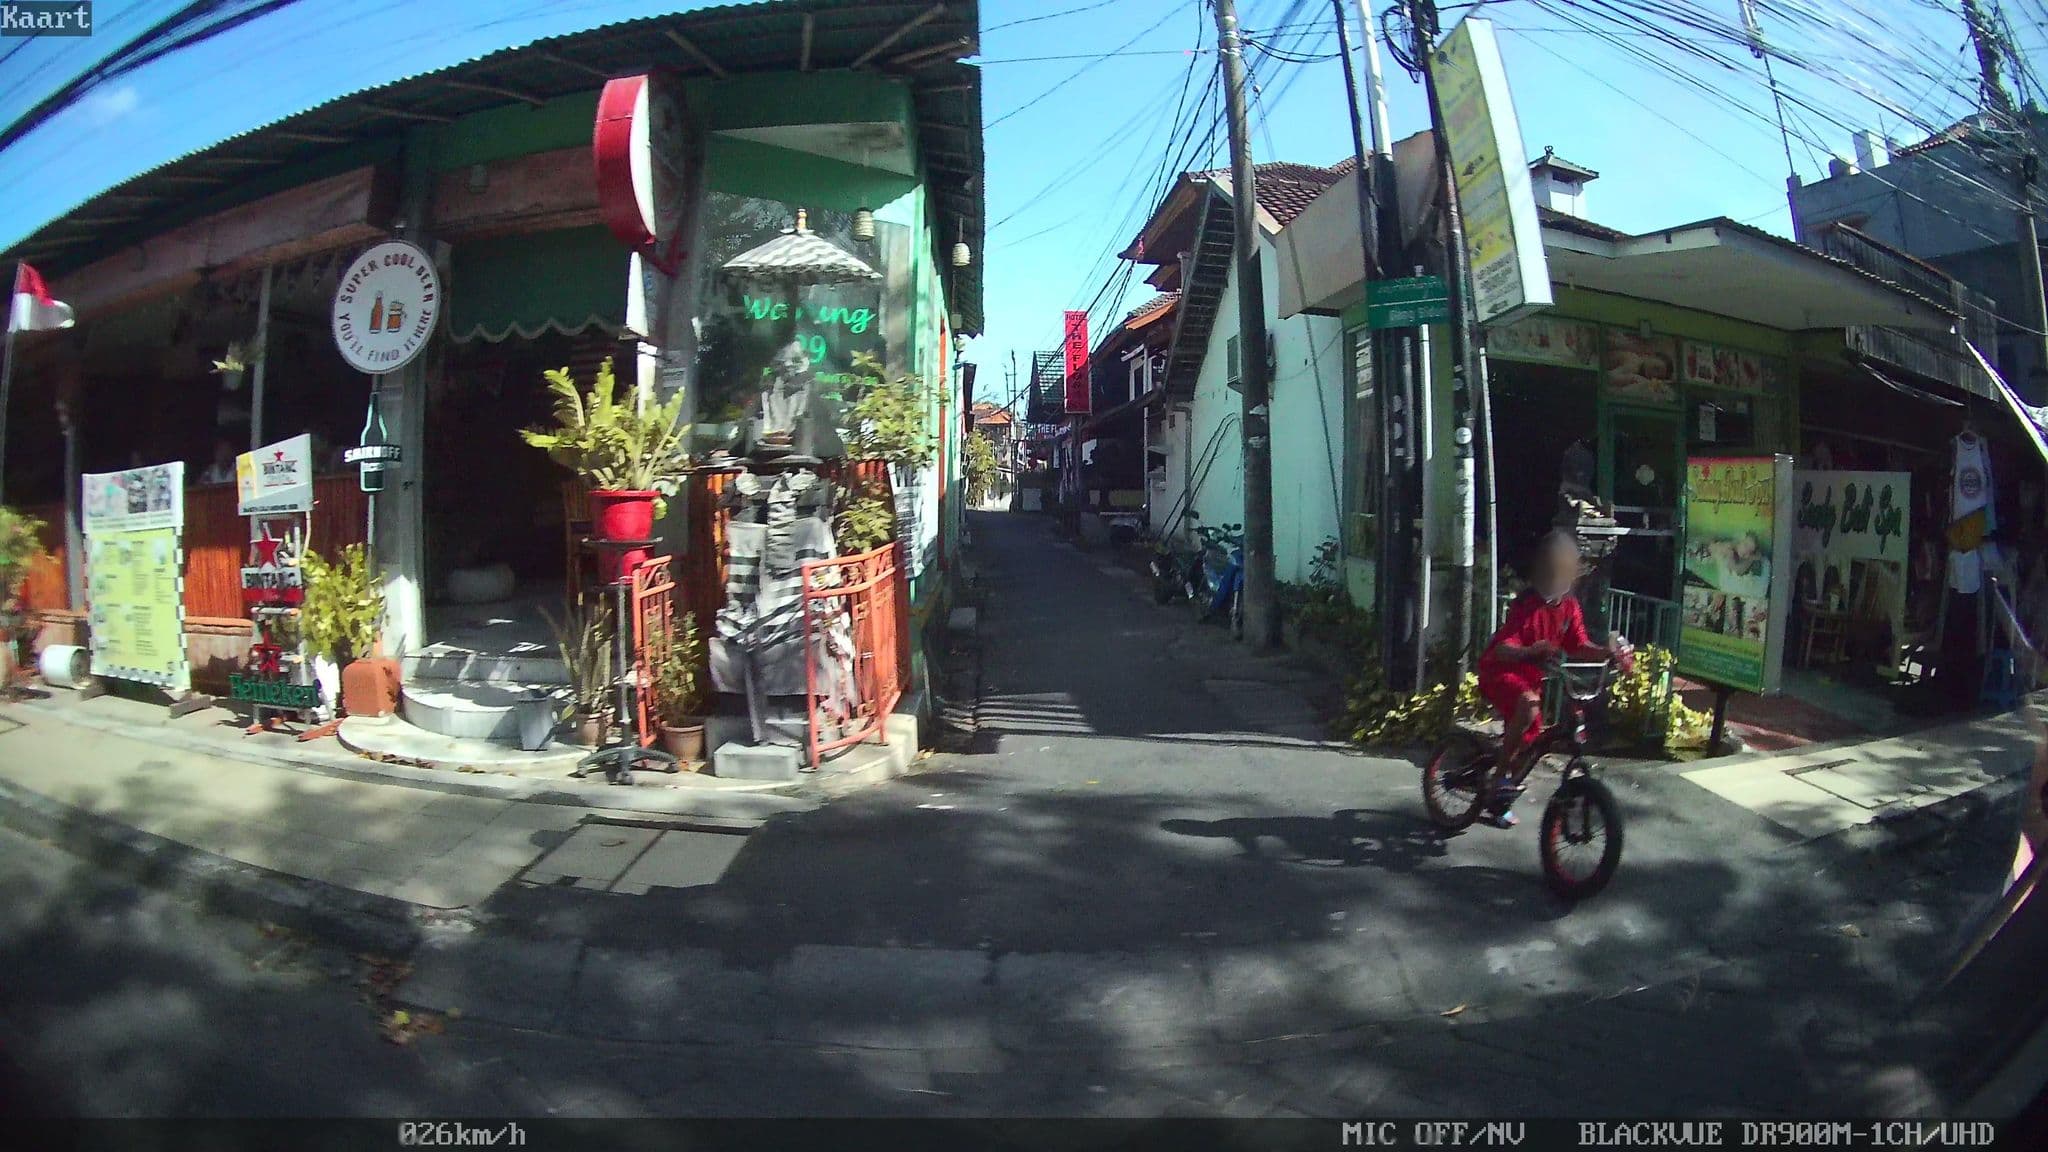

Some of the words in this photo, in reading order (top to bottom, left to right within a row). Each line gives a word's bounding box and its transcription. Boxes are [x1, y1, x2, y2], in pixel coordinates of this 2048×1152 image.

[341, 259, 379, 304] SUPER
[384, 253, 415, 269] COOL
[415, 265, 434, 303] BEER
[368, 350, 400, 362] FIND
[229, 674, 321, 708] Heineken
